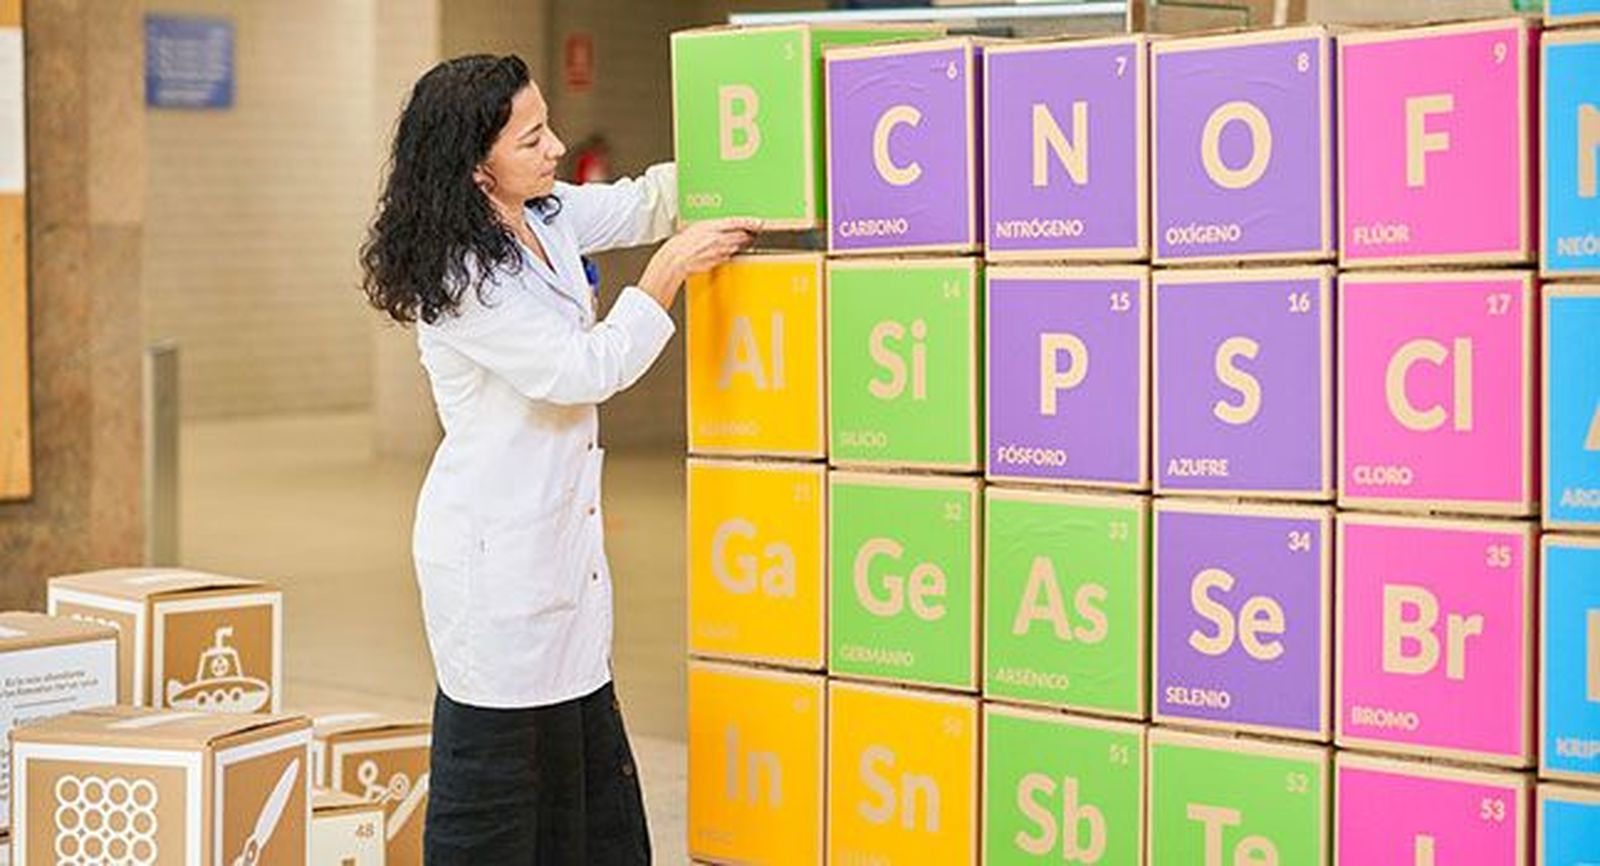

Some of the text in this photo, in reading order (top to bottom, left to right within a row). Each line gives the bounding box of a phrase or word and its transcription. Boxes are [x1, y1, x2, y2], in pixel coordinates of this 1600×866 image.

[1297, 52, 1310, 73] 8
[1494, 43, 1507, 64] 9
[946, 60, 958, 79] 6
[1115, 57, 1127, 78] 7
[719, 84, 761, 162] B
[872, 104, 923, 186] C
[1032, 101, 1089, 187] N
[1201, 100, 1273, 189] O
[1405, 93, 1454, 188] F
[840, 218, 909, 237] CARBONO
[996, 216, 1084, 238] NITRÓGENO
[1166, 220, 1241, 246] OXÍGENO
[1353, 220, 1410, 245] FLÚOR
[1557, 232, 1600, 256] NEÓ
[1110, 291, 1131, 311] 15
[1288, 293, 1310, 313] 16
[1486, 293, 1512, 315] 17
[717, 311, 786, 391] Al
[868, 319, 927, 400] Si
[1040, 332, 1089, 416] P
[1213, 336, 1262, 425] S
[1385, 337, 1473, 431] Cl
[997, 445, 1067, 467] FÓSFORO
[1167, 458, 1229, 477] AZUFRE
[1353, 465, 1413, 485] CLORO
[1109, 521, 1129, 541] 33
[1287, 531, 1311, 552] 34
[712, 517, 796, 597] Ga
[1486, 545, 1512, 568] 35
[854, 537, 947, 620] Ge
[1012, 555, 1108, 645] As
[1188, 567, 1285, 661] Se
[1382, 583, 1484, 681] Br
[1166, 686, 1230, 709] SELENIO
[1351, 706, 1419, 730] BROMO
[725, 721, 782, 808] In
[859, 744, 940, 832] Sn
[1286, 772, 1308, 793] 52
[1015, 772, 1106, 864] Sb
[1481, 798, 1505, 822] 53
[355, 821, 374, 839] 48
